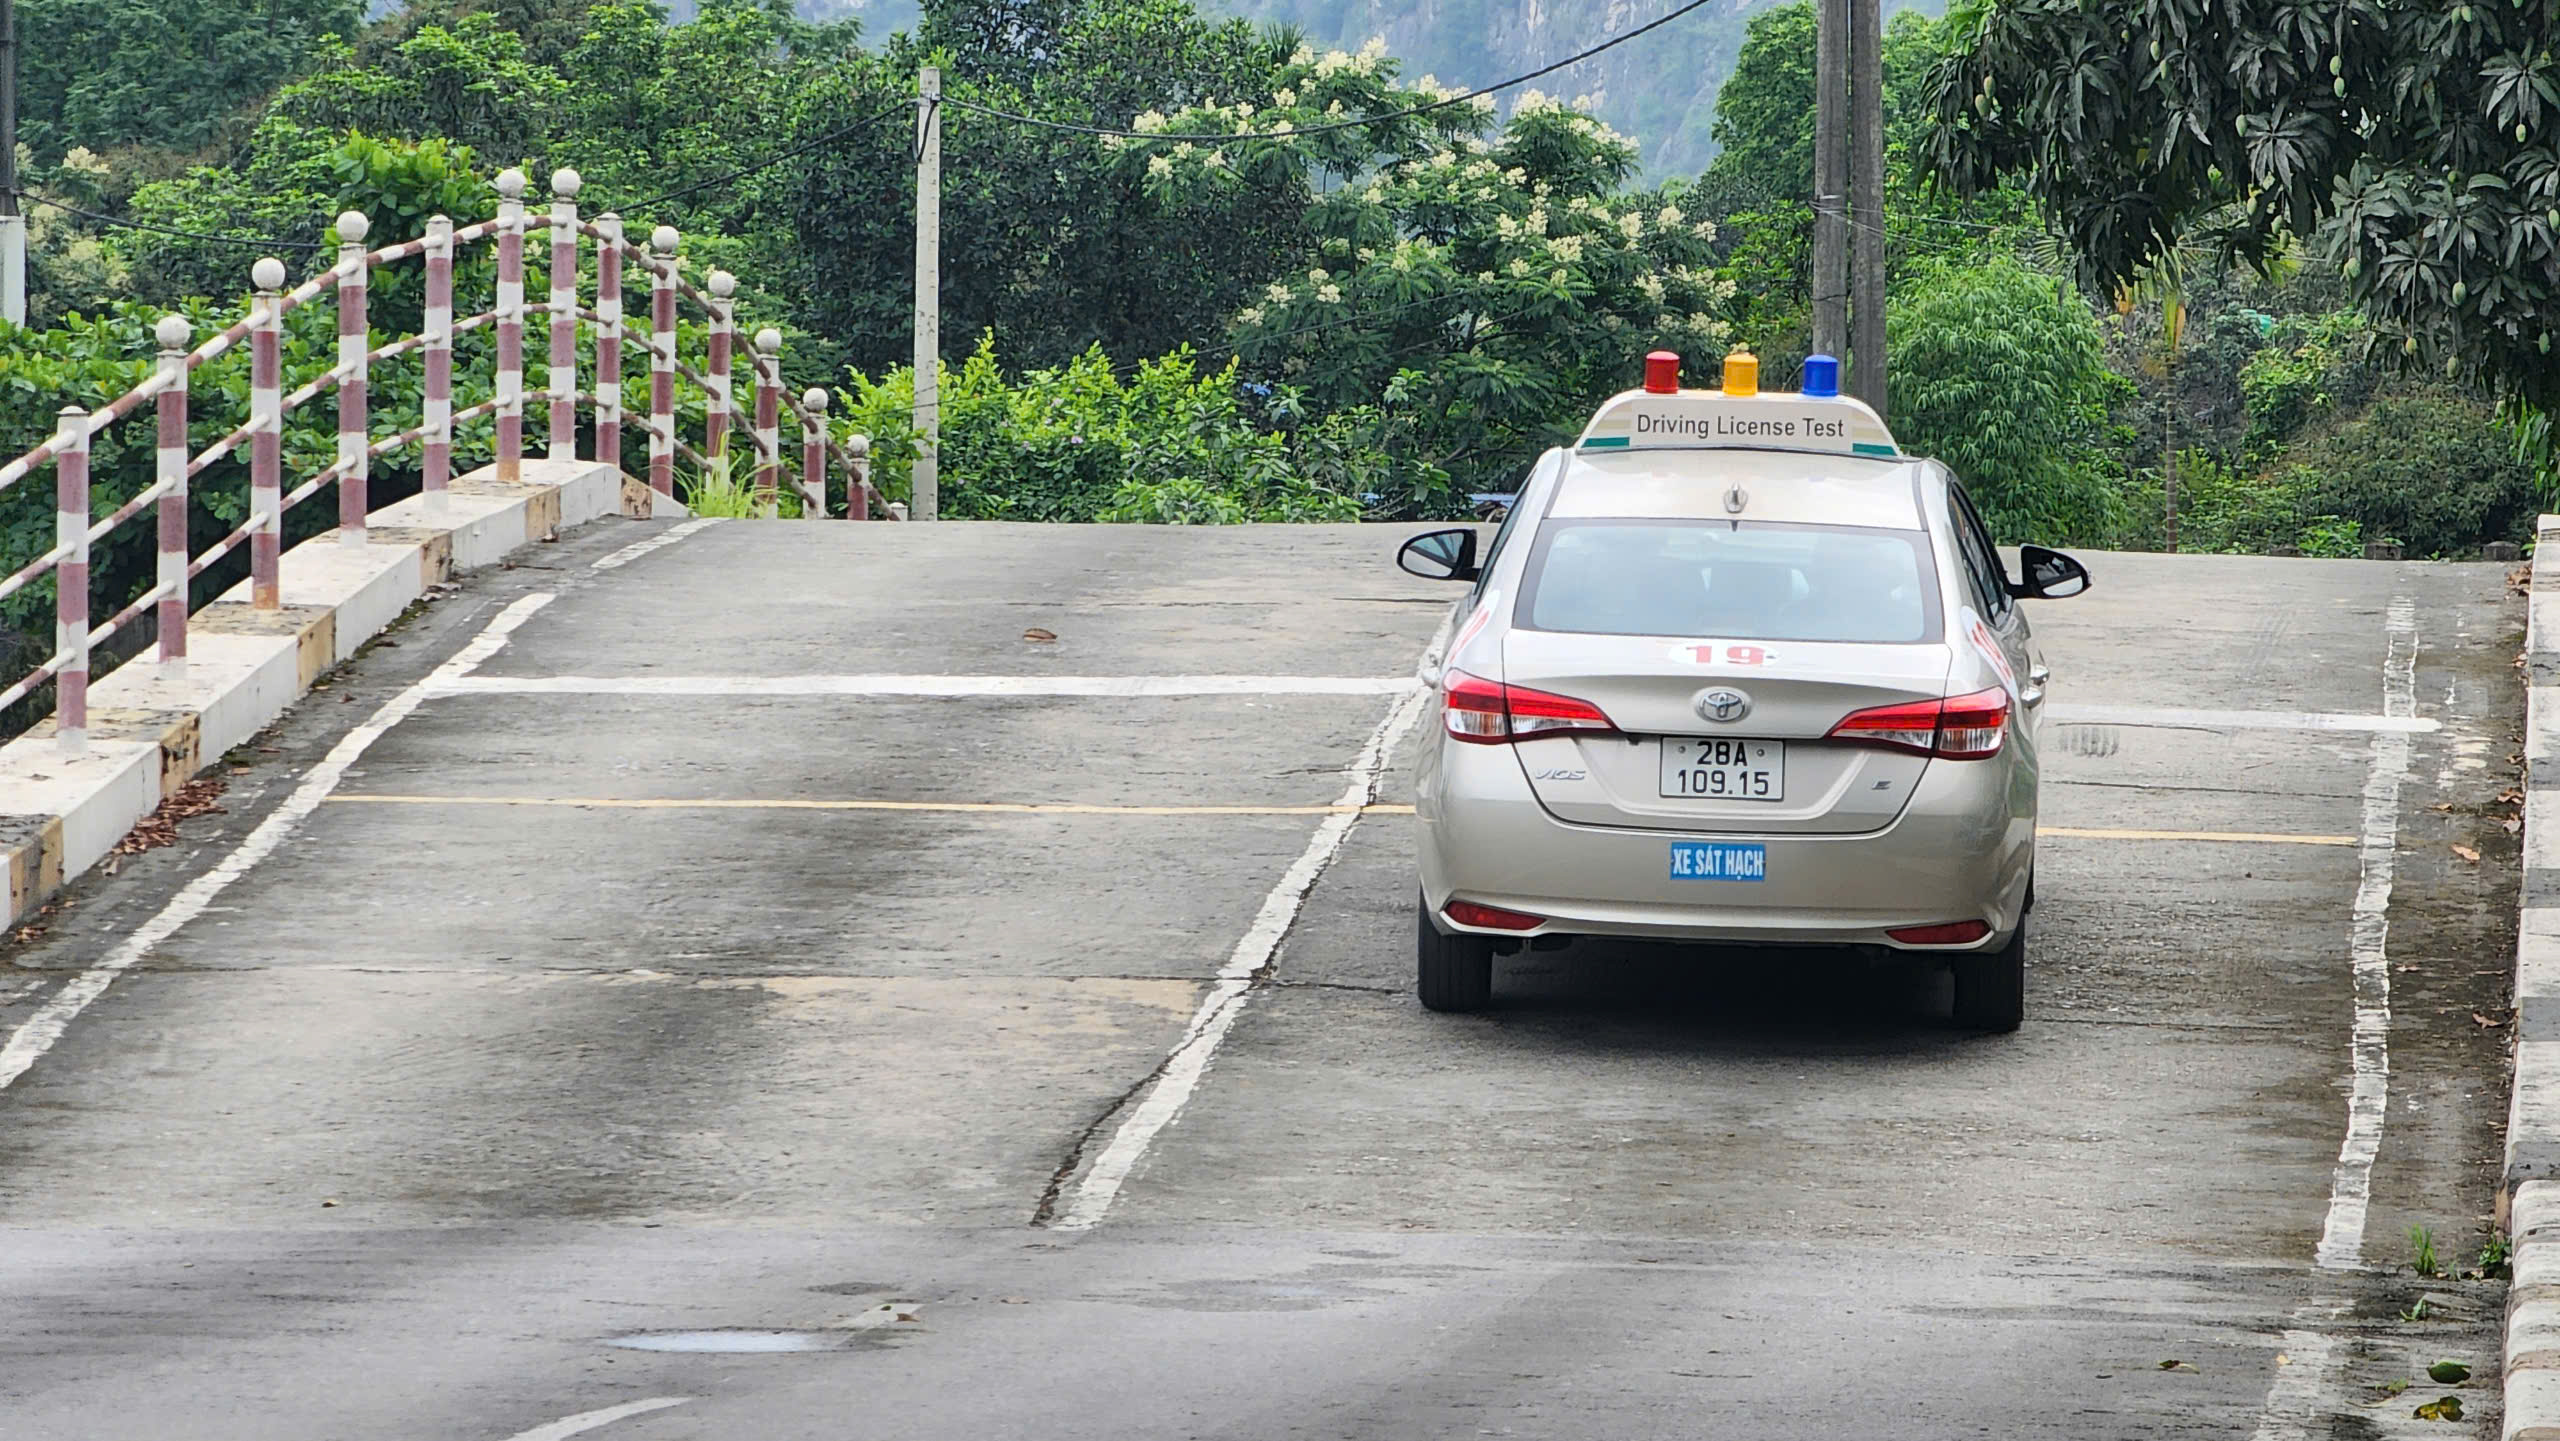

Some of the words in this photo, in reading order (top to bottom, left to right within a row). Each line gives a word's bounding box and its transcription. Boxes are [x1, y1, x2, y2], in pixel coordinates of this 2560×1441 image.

[1637, 414, 1709, 439] Driving
[1717, 416, 1795, 436] License
[1802, 418, 1844, 437] Test
[1686, 645, 1765, 664] 19
[1697, 741, 1747, 766] 28A
[1678, 769, 1769, 795] 109.15
[1673, 849, 1691, 874] XE
[1695, 845, 1722, 875] SÁT
[1725, 850, 1763, 880] HẠCH
